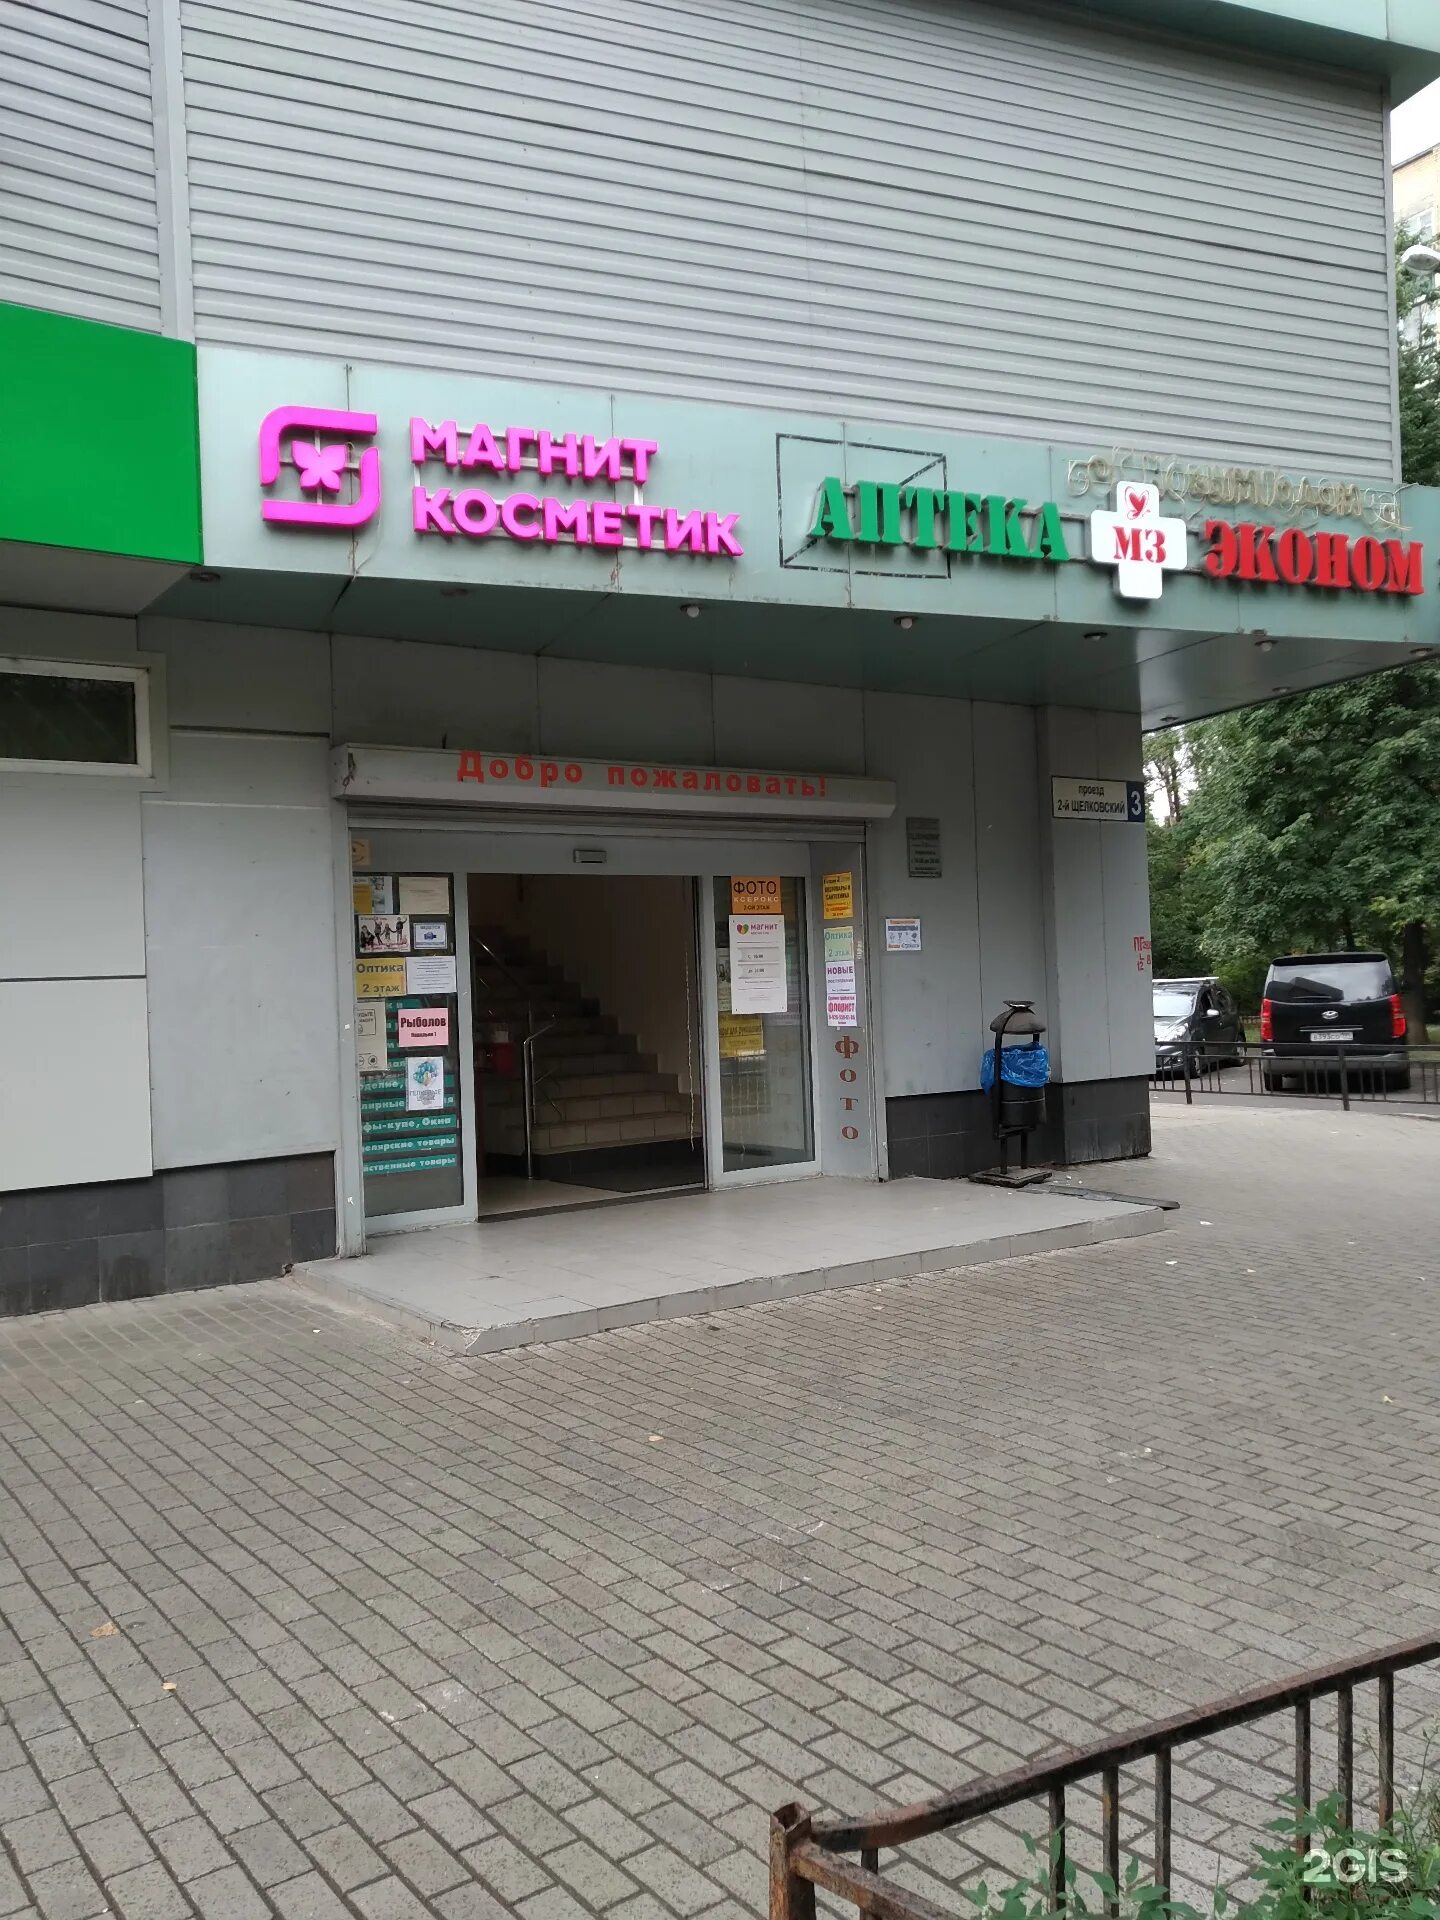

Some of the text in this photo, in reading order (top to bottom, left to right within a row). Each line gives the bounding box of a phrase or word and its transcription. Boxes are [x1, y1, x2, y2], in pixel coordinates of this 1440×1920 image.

[410, 416, 658, 485] МАГНИТ
[412, 486, 744, 558] КОСМЕТИК
[808, 477, 1070, 561] АПТЕКА
[1112, 525, 1167, 563] МЗ
[1205, 519, 1425, 596] ЭКОНОМ
[457, 751, 828, 798] Добро пожаловать!
[1078, 785, 1105, 797] проезд
[1057, 799, 1126, 815] 2-й ЩЕЛКОВСКИЙ
[1130, 790, 1142, 816] 3
[733, 881, 777, 894] ФОТО
[750, 923, 779, 931] магнит
[825, 931, 852, 941] Оптика
[829, 948, 833, 958] 2
[356, 961, 404, 974] Оптика
[827, 966, 854, 975] НОВЫЕ
[362, 983, 370, 994] 2
[400, 1016, 447, 1028] Рыболов
[422, 1117, 452, 1126] Окна
[417, 1137, 455, 1147] товары
[420, 1157, 456, 1167] товары
